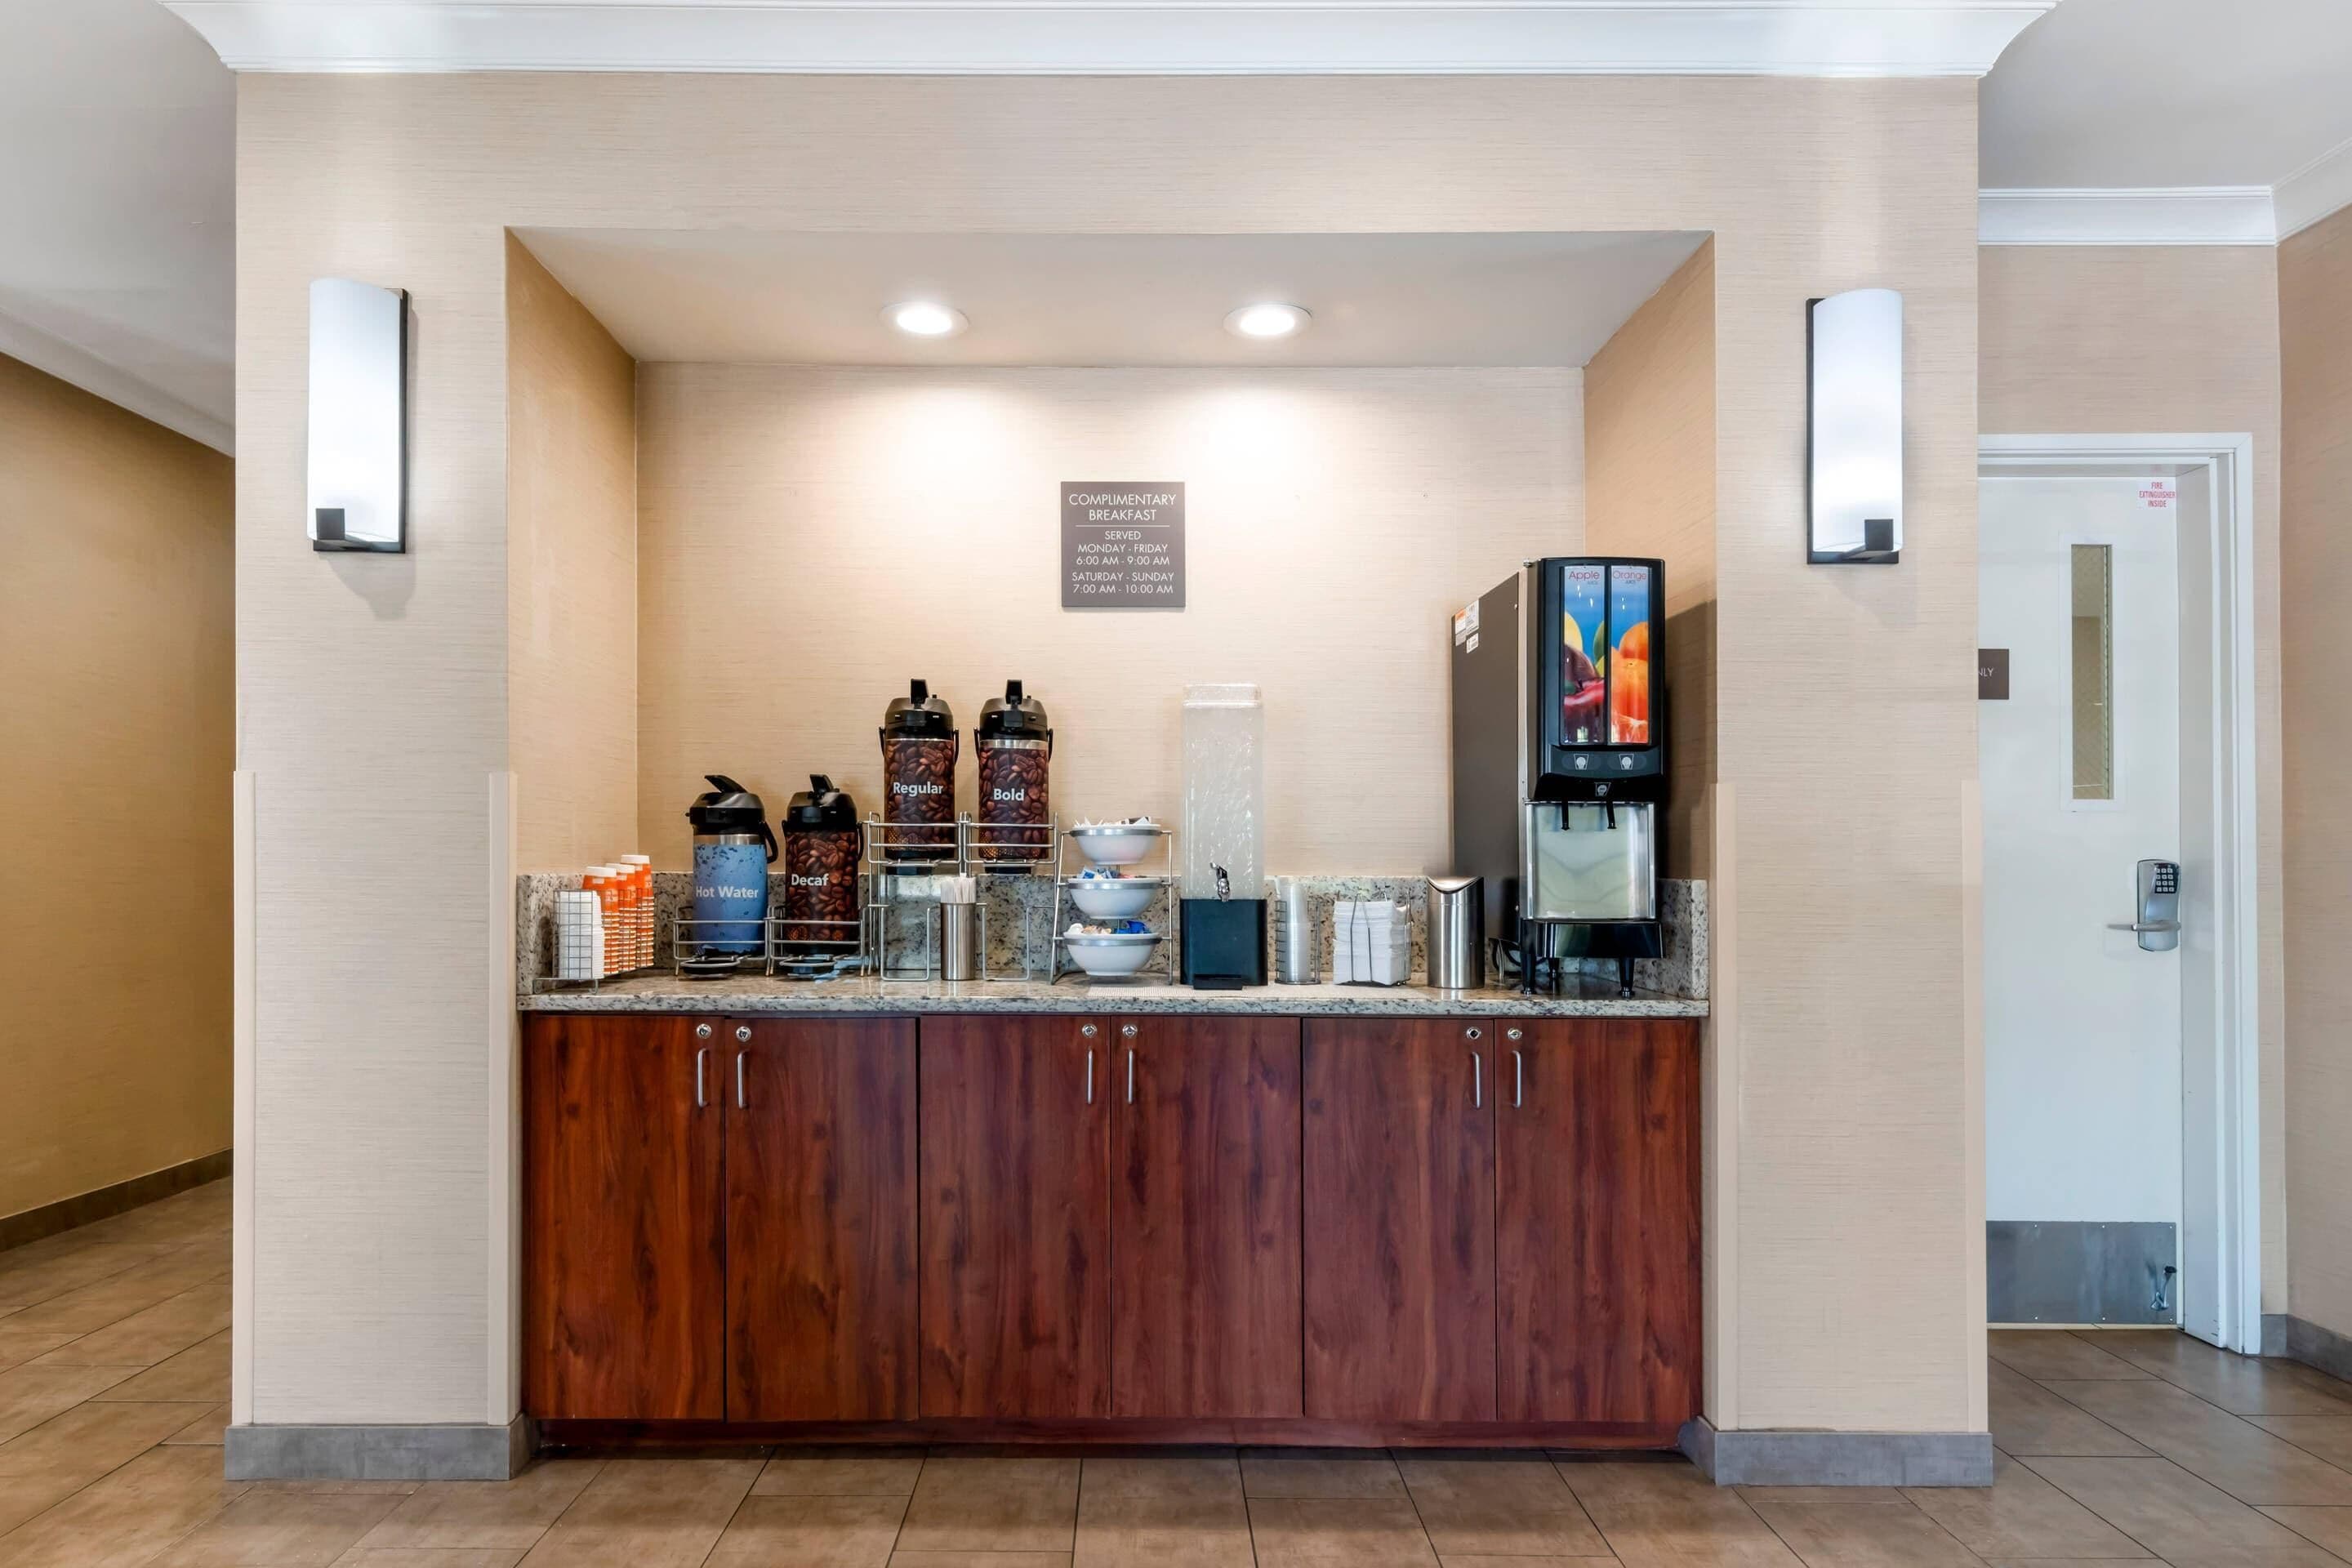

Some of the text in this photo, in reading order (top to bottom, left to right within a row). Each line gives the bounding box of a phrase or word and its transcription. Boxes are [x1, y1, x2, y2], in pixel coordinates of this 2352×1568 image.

[2150, 482, 2163, 490] FIRE
[1068, 493, 1177, 506] COMPLIMENTARY
[1089, 510, 1157, 521] BREAKFAST
[1104, 531, 1142, 540] SERVED
[1077, 544, 1126, 553] MONDAY
[1134, 544, 1168, 553] FRIDAY
[1076, 556, 1099, 565] 6:00
[1102, 556, 1119, 565] AM
[1127, 556, 1150, 565] 9:00
[1152, 556, 1170, 565] AM
[1071, 572, 1124, 581] SATURDAY
[1132, 572, 1174, 581] SUNDAY
[1568, 571, 1600, 581] Apple
[1613, 571, 1647, 581] Orange
[1073, 585, 1096, 594] 7:00
[1098, 585, 1116, 594] AM
[1125, 585, 1153, 594] 10:00
[1156, 585, 1174, 594] AM
[1979, 667, 1993, 677] NLY
[893, 782, 944, 797] Regular
[993, 788, 1025, 801] Bold
[791, 873, 830, 886] Decaf
[696, 886, 759, 898] Hot Water
